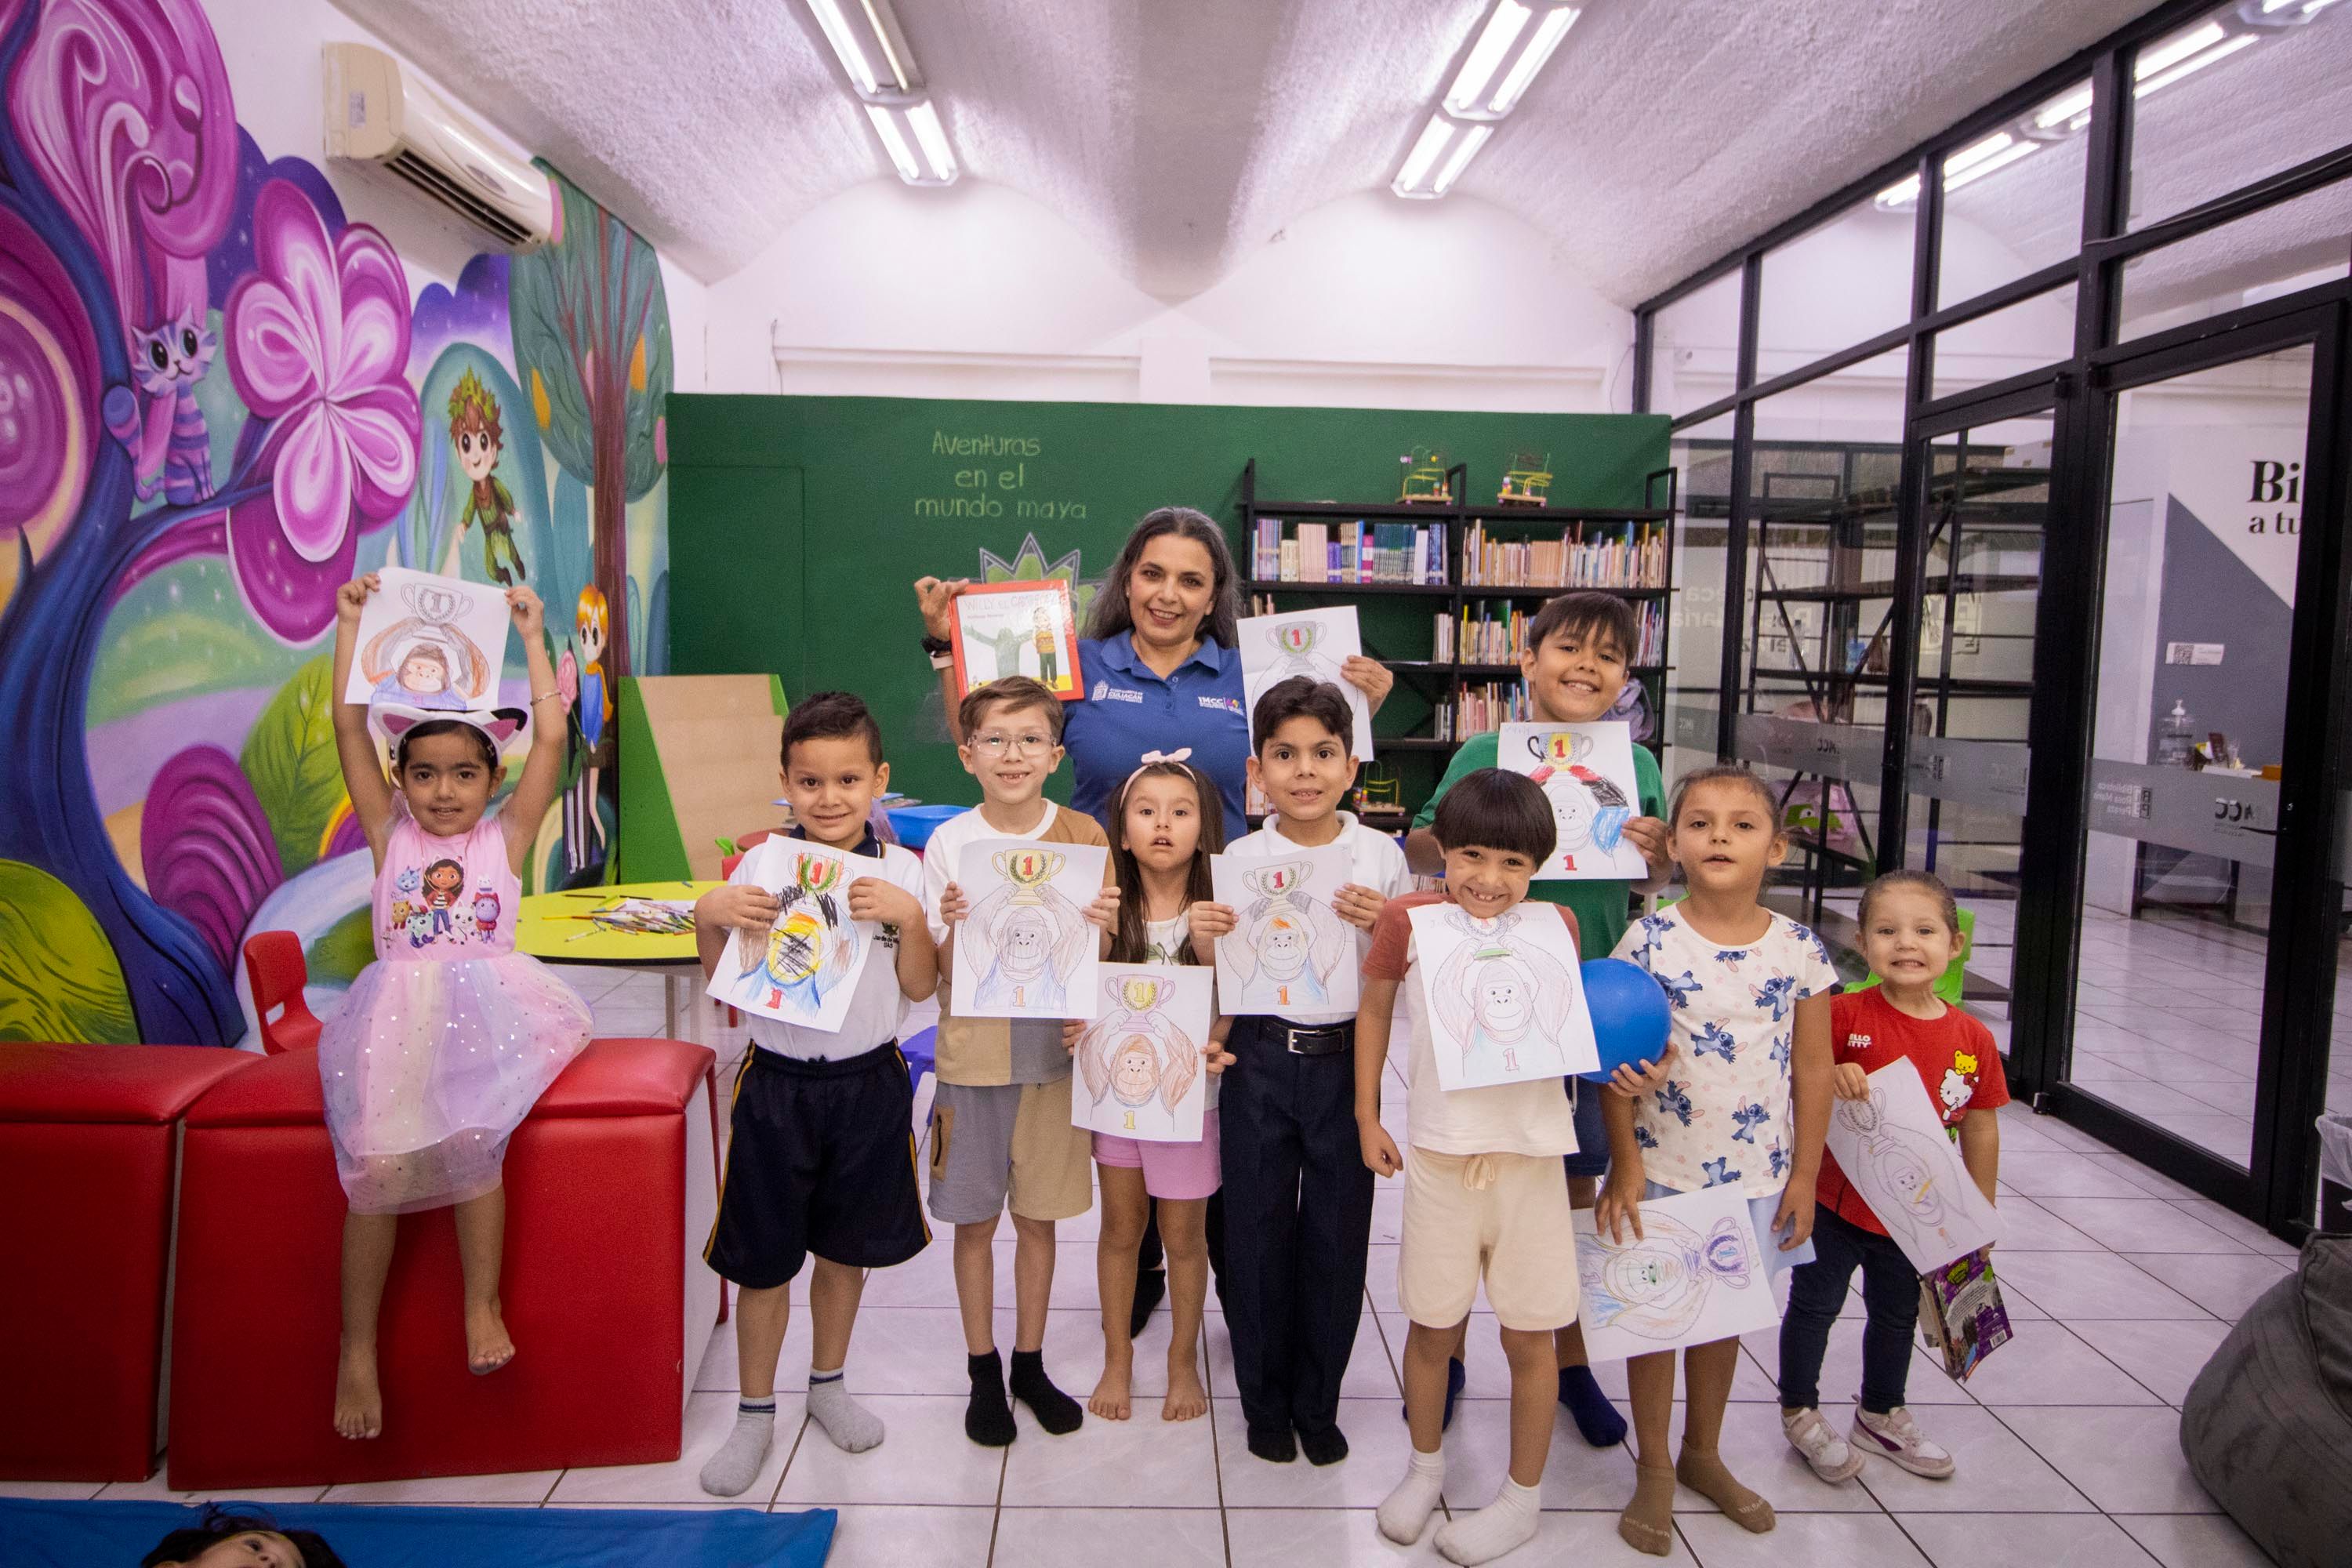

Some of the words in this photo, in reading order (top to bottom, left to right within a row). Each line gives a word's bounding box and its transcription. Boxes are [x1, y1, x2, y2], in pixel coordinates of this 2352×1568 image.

[932, 431, 1041, 456] Aventuras
[955, 469, 988, 488] en
[998, 463, 1024, 490] el
[915, 494, 1003, 517] mundo
[1018, 499, 1087, 520] maya
[2249, 516, 2266, 534] a
[1292, 629, 1302, 647] 1
[1198, 695, 1224, 705] IMCC
[1554, 739, 1566, 758] 1
[810, 862, 822, 884] 1
[1022, 855, 1034, 876] 1
[1563, 855, 1577, 871] 1
[1272, 871, 1285, 889] 1
[1012, 985, 1026, 1007] 1
[1134, 982, 1145, 1002] 1
[1277, 985, 1290, 1006] 1
[1502, 1047, 1520, 1072] 1
[1123, 1110, 1136, 1131] 1
